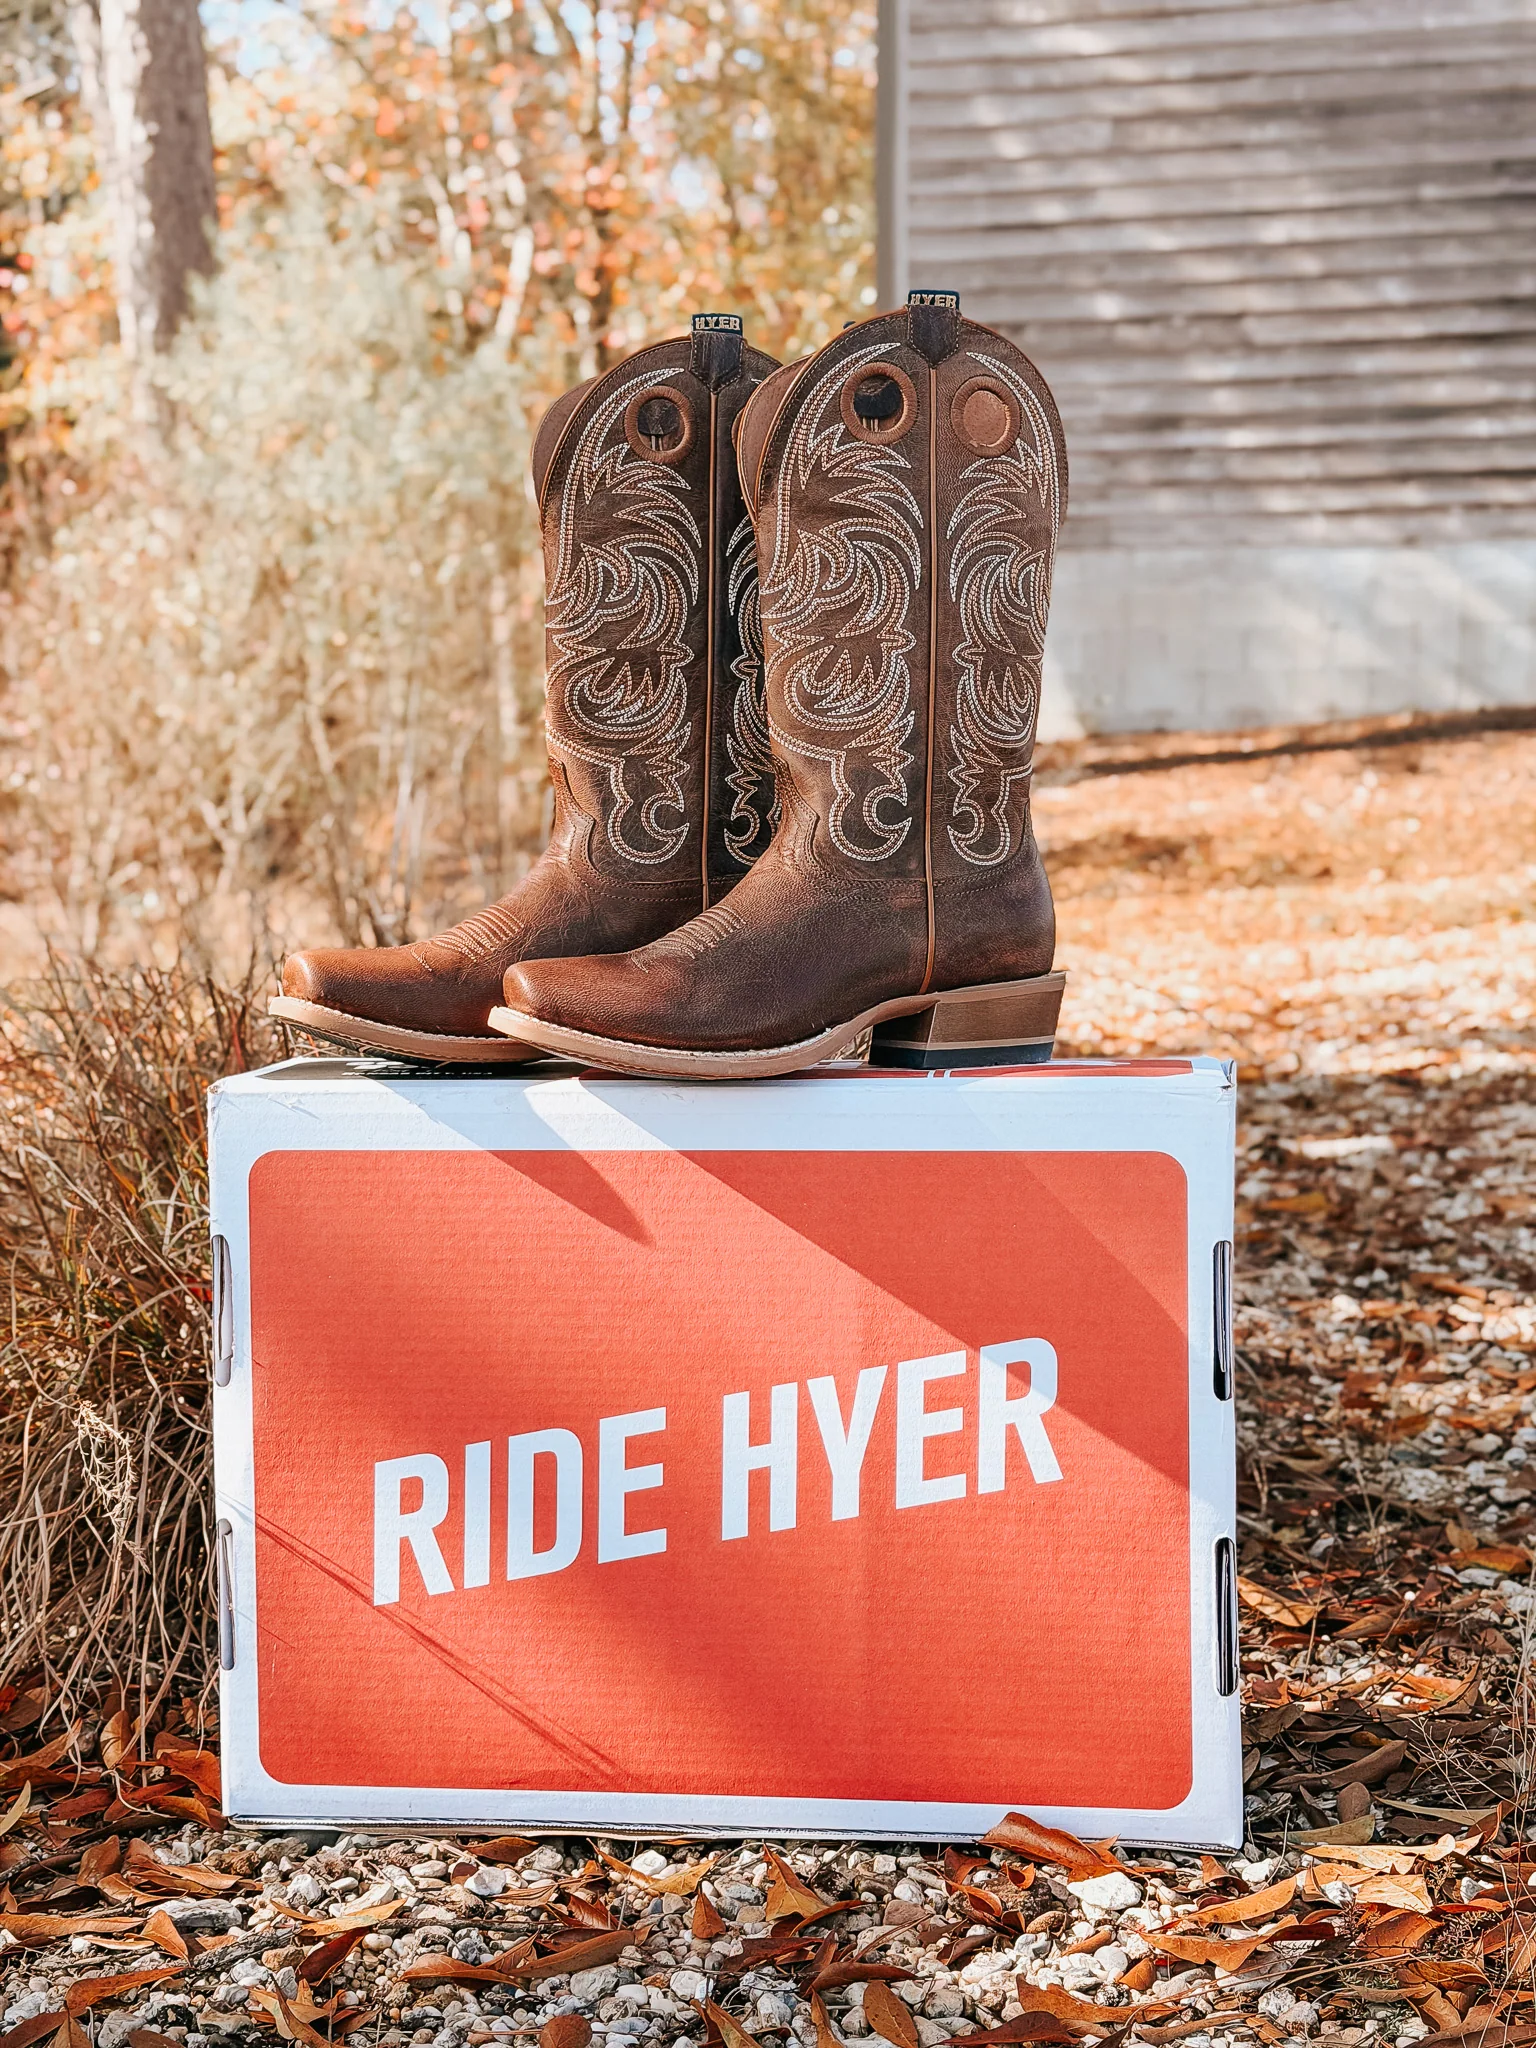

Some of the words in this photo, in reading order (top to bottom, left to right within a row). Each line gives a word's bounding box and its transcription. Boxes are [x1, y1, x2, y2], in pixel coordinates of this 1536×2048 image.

[911, 294, 956, 308] HYER
[695, 316, 740, 330] HYER
[373, 1406, 667, 1607] RIDE
[721, 1336, 1064, 1541] HYER
